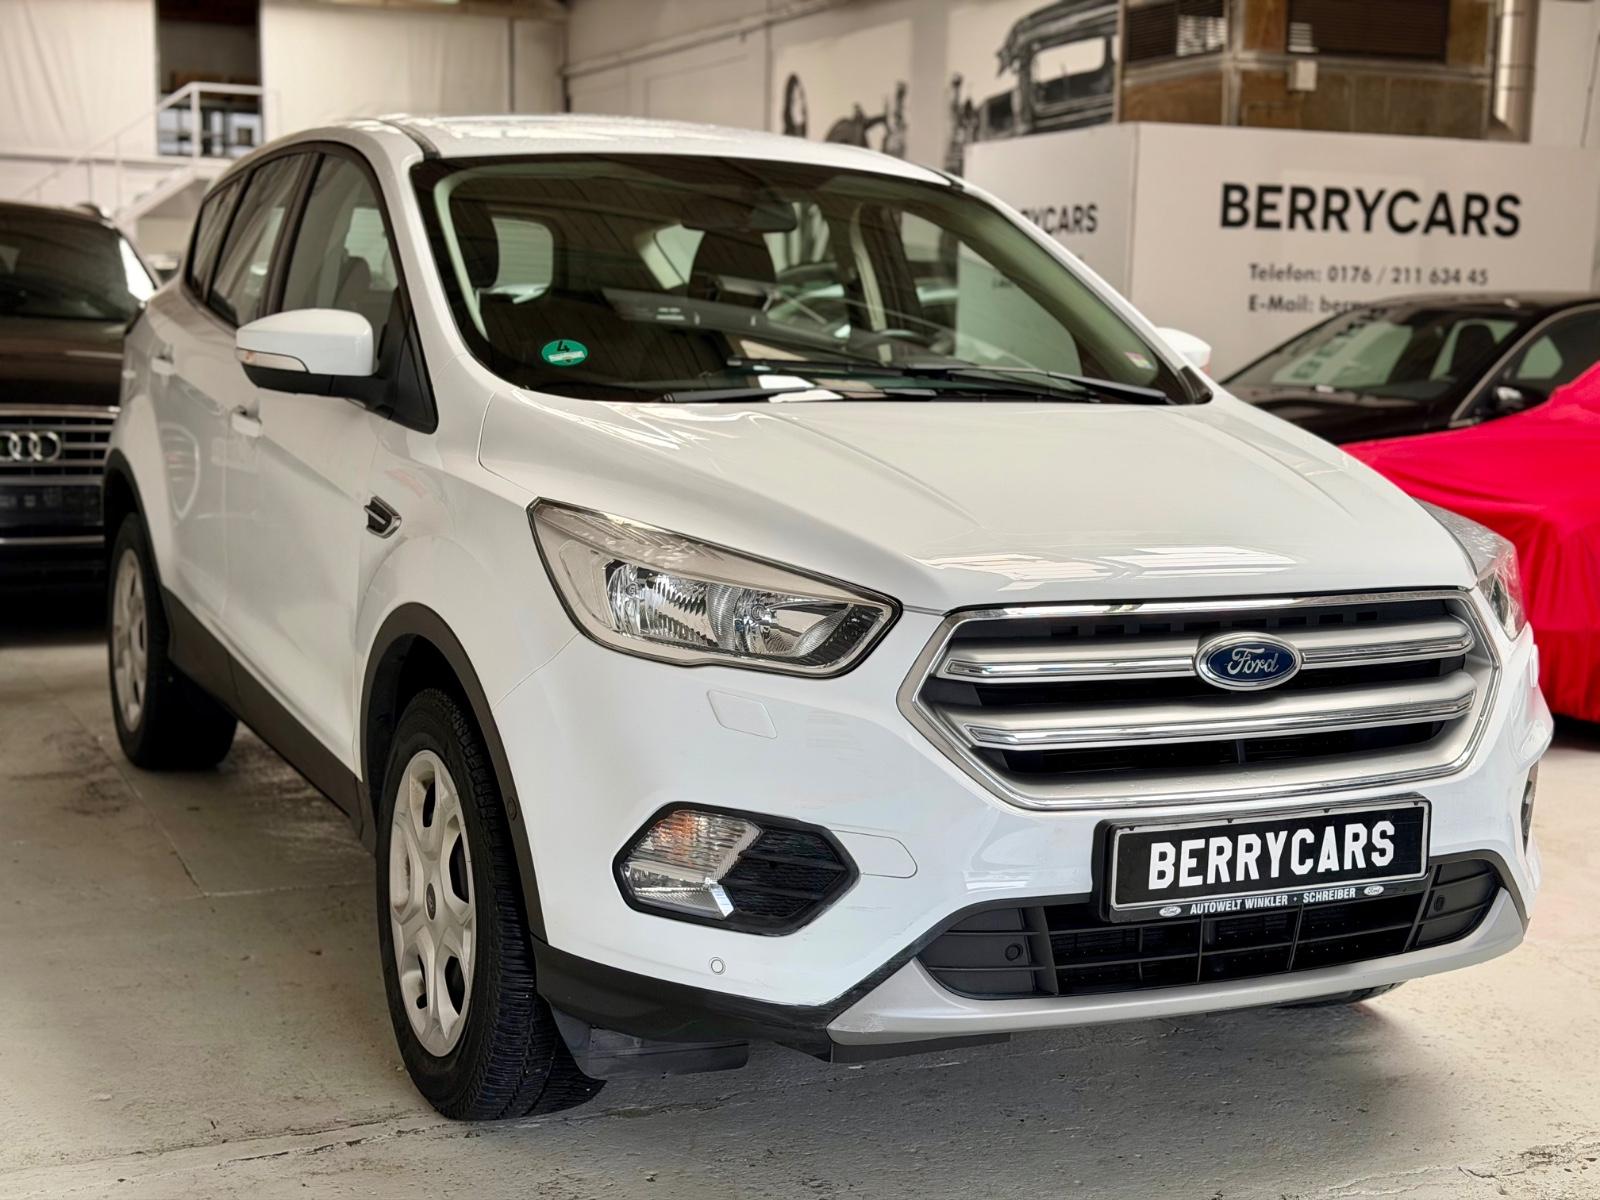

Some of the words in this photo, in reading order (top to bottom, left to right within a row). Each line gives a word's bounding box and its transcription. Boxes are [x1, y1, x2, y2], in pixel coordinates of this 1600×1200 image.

[1021, 203, 1098, 234] YCARS
[1220, 182, 1521, 238] BERRYCARS
[1249, 262, 1321, 281] Telefon:
[1327, 264, 1373, 283] 0176
[1391, 266, 1422, 284] 211
[1429, 266, 1461, 285] 634
[1466, 268, 1489, 287] 45
[1248, 293, 1313, 312] E-Mail:
[1226, 647, 1279, 675] Ford
[1148, 820, 1395, 890] BERRYCARS
[1190, 899, 1242, 915] AUTOWELT
[1245, 895, 1288, 909] WINKLER
[1303, 888, 1356, 903] SCHREIBER
